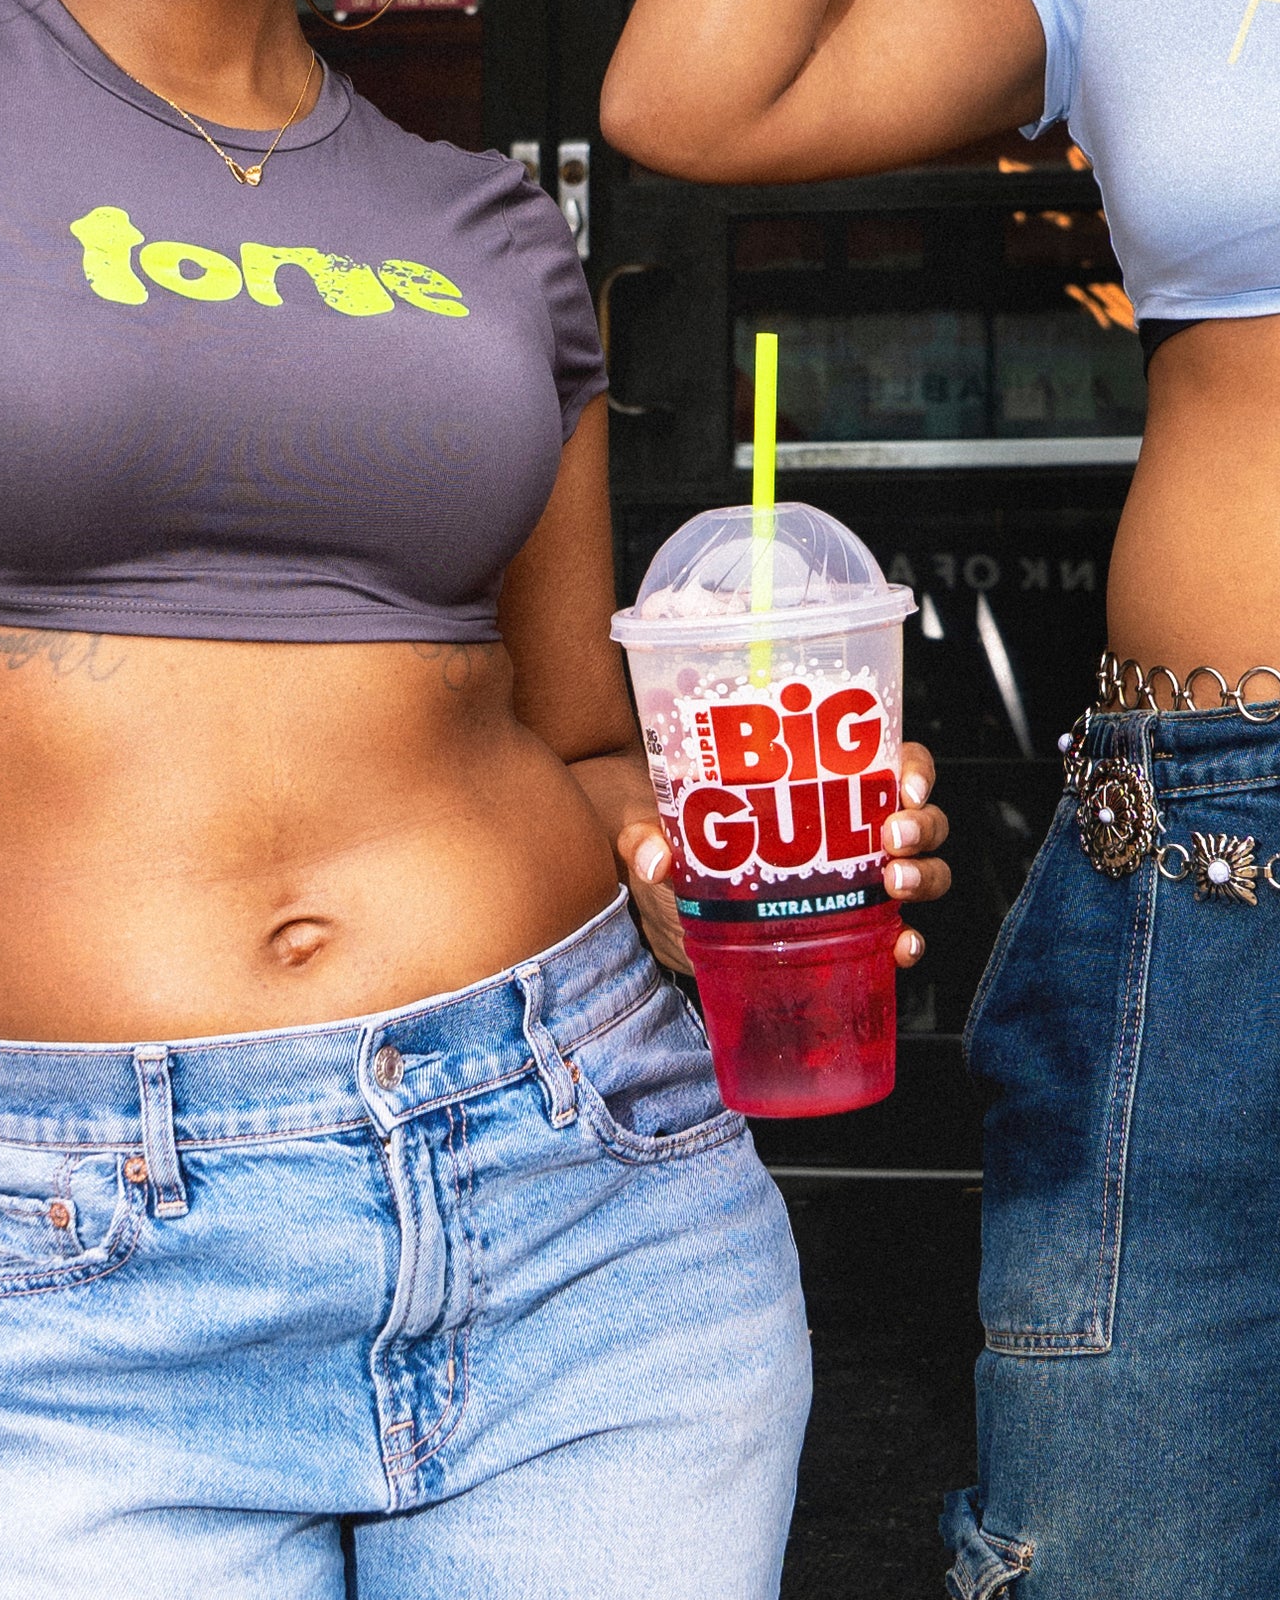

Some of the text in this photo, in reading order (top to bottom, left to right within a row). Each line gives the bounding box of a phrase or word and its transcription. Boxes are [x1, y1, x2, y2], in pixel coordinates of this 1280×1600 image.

[70, 206, 470, 317] tone
[695, 711, 719, 782] SUPER
[683, 768, 898, 872] GULP
[757, 890, 865, 917] EXTRA LARGE
